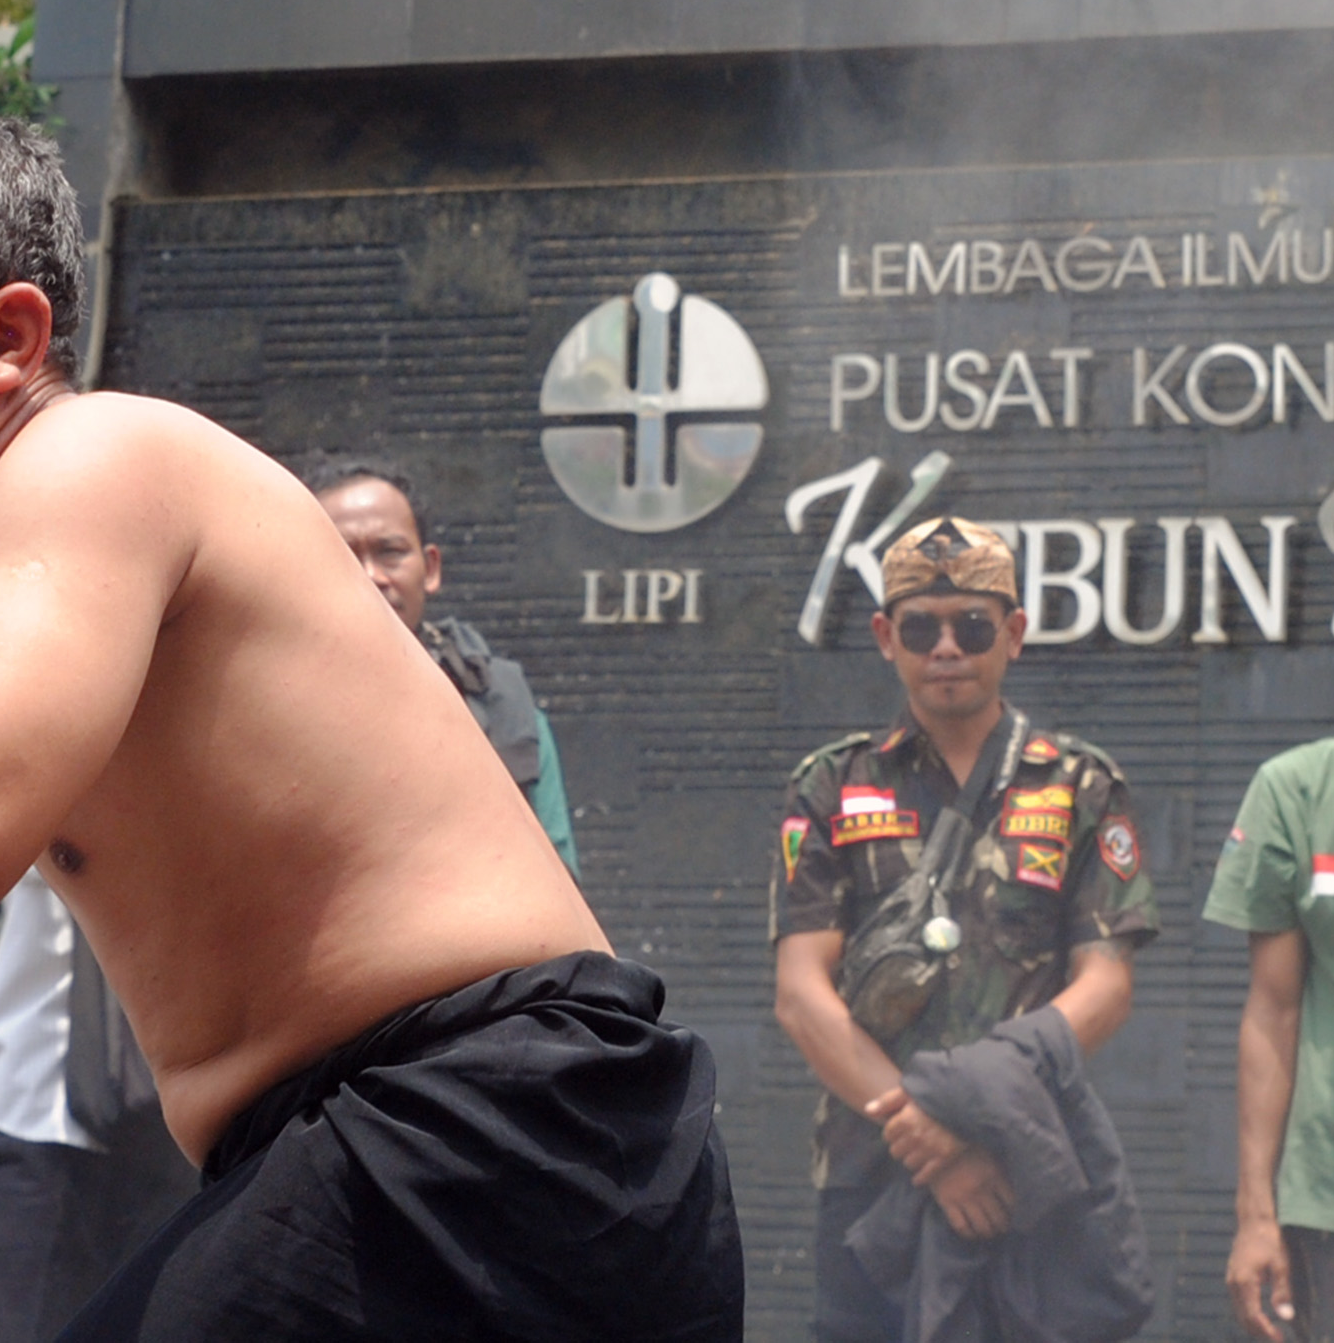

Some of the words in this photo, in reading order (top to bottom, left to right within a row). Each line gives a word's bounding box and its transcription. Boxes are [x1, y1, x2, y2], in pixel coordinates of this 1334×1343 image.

[838, 233, 1166, 298] LEMBAGA
[1181, 226, 1334, 288] ILMU
[830, 347, 1095, 433] PUSAT
[785, 449, 1298, 645] KBUN
[582, 569, 704, 625] LIPI
